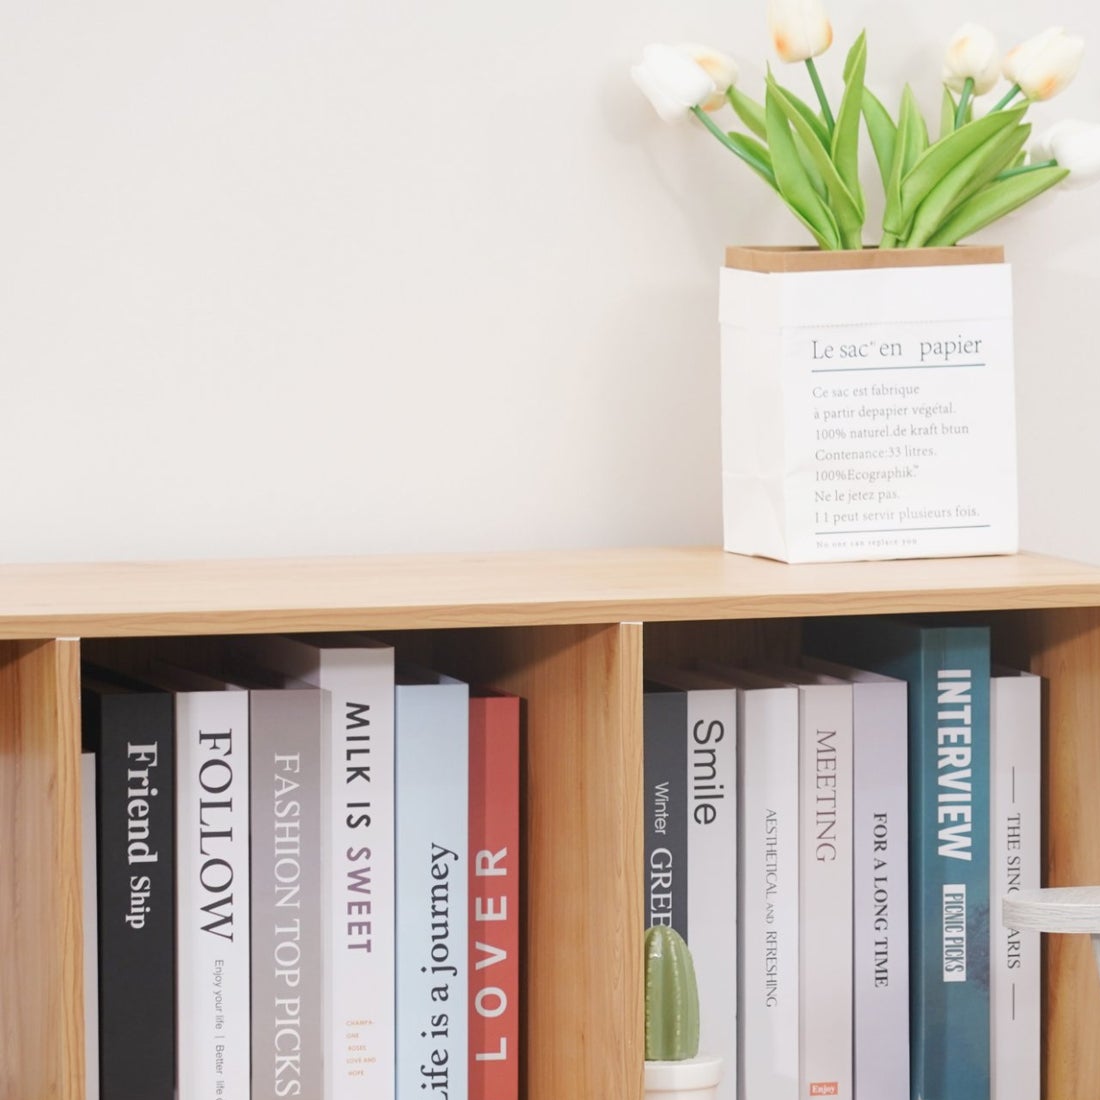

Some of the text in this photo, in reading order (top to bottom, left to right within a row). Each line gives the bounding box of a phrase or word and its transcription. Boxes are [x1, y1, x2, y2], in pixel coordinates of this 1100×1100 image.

[812, 340, 834, 360] Le
[879, 342, 902, 357] en
[920, 334, 982, 362] papier
[812, 383, 920, 400] Ce sac est fabrique
[823, 407, 855, 422] partir
[858, 405, 908, 421] depapier
[815, 428, 847, 441] 100%
[910, 423, 938, 437] kraft
[904, 445, 937, 458] litres.
[815, 488, 900, 504] Ne le jetez pas.
[833, 512, 859, 526] peut
[862, 508, 895, 522] servir
[899, 507, 952, 522] plusieurs
[955, 505, 980, 518] fois.
[693, 719, 724, 826] Smile
[937, 669, 972, 861] INTERVIEW
[816, 729, 837, 863] MEETING
[125, 741, 158, 929] Friend Ship
[198, 728, 234, 943] FOLLOW
[345, 701, 372, 953] MILK IS SWEET
[1007, 813, 1021, 850] THE
[651, 781, 673, 929] Winter GREE
[765, 808, 777, 900] AESTHETICAL
[421, 842, 459, 976] journey
[766, 902, 774, 925] AND
[873, 812, 888, 988] FOR A LONG TIME
[274, 752, 301, 1098] FASHION TOP PICKS
[944, 892, 965, 973] PICNIC PICKS
[475, 846, 508, 1062] LOVER
[1007, 927, 1021, 969] ARIS
[213, 960, 225, 988] Enjoy
[213, 990, 224, 1012] your
[430, 984, 449, 1002] a
[215, 1015, 225, 1029] life
[420, 1013, 449, 1039] is
[214, 1044, 225, 1074] Better
[215, 1080, 225, 1095] life
[812, 1084, 835, 1096] Enjoy
